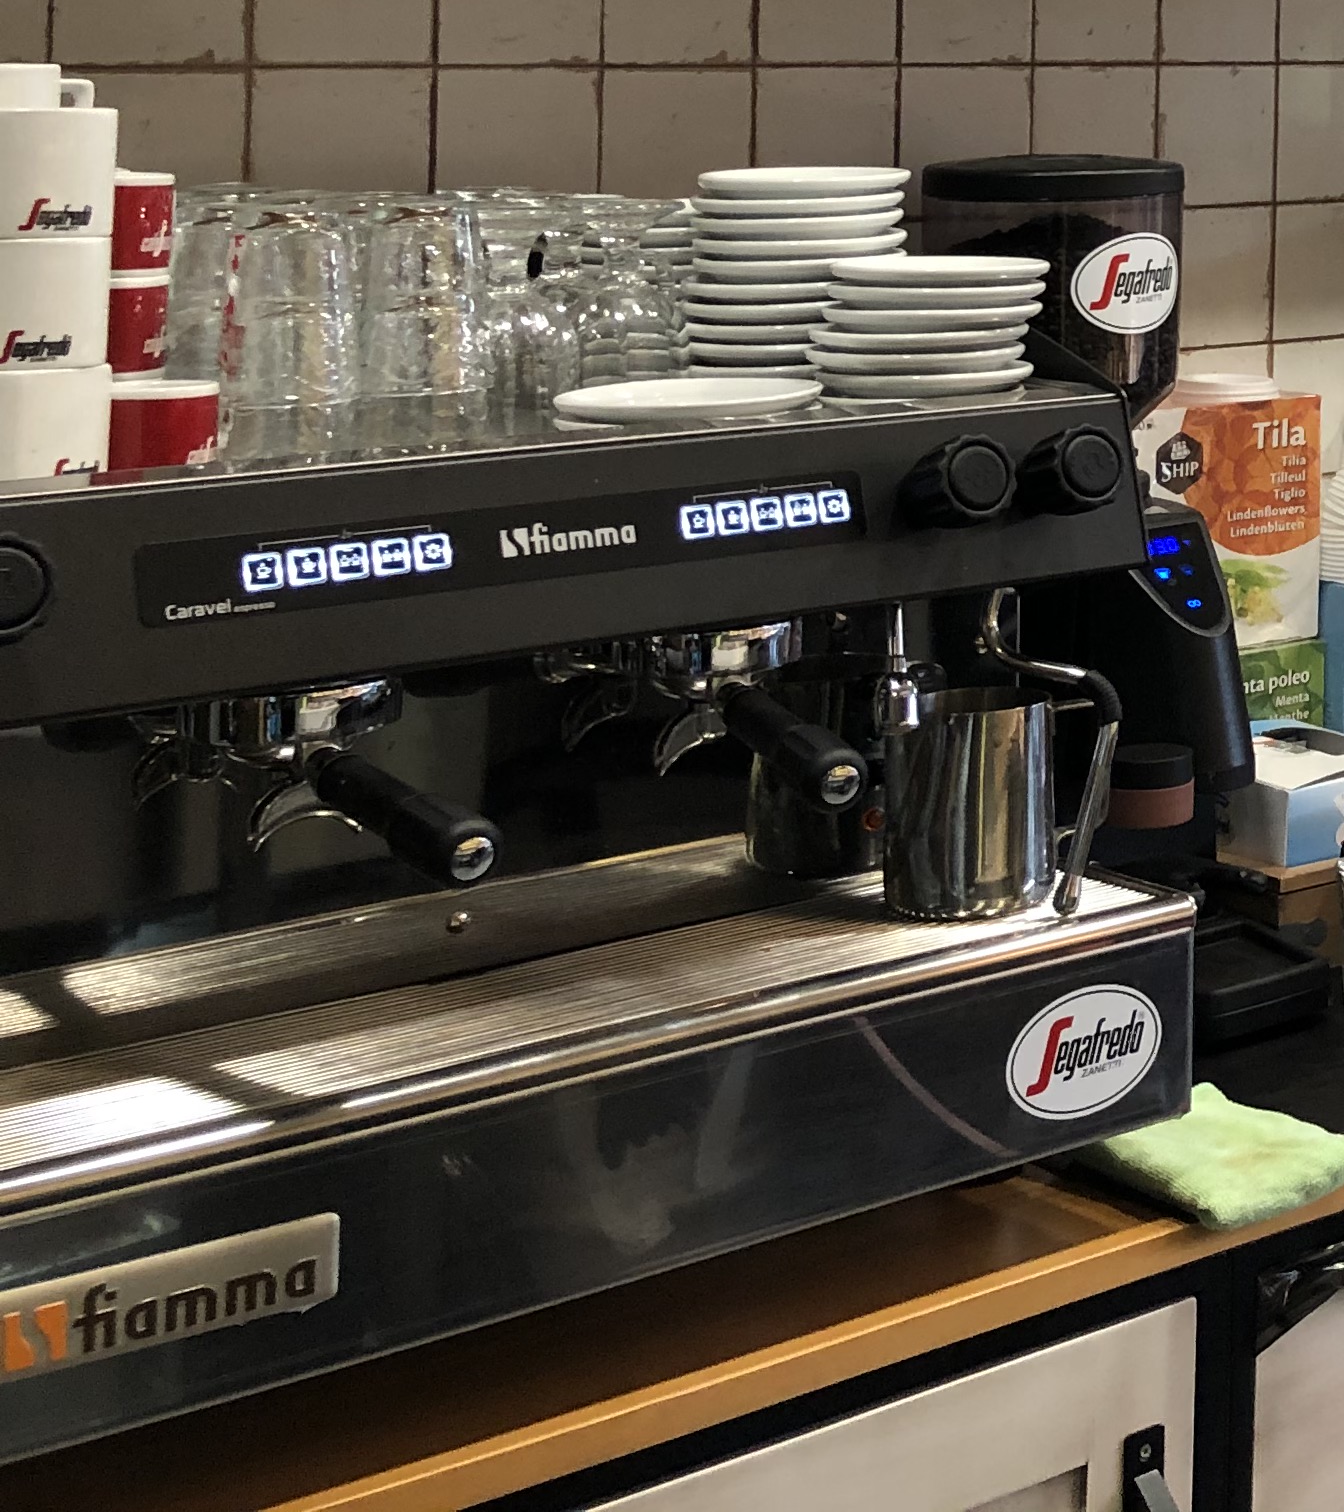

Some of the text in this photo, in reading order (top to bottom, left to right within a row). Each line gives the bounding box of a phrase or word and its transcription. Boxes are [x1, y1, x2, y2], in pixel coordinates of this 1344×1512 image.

[1089, 253, 1174, 311] Segafredo
[1252, 417, 1308, 450] Tila
[1160, 460, 1200, 483] SHIP
[1281, 454, 1308, 468] Tilia
[1269, 473, 1307, 486] Tilleul
[1272, 487, 1307, 504] Tiglio
[529, 523, 638, 556] fiamma
[164, 598, 233, 621] Caravel
[1268, 668, 1311, 694] poleo
[1275, 691, 1311, 709] Menta
[1025, 1008, 1146, 1098] Segafredo
[1080, 1060, 1123, 1078] ZANETTI
[71, 1256, 319, 1356] fiamma
